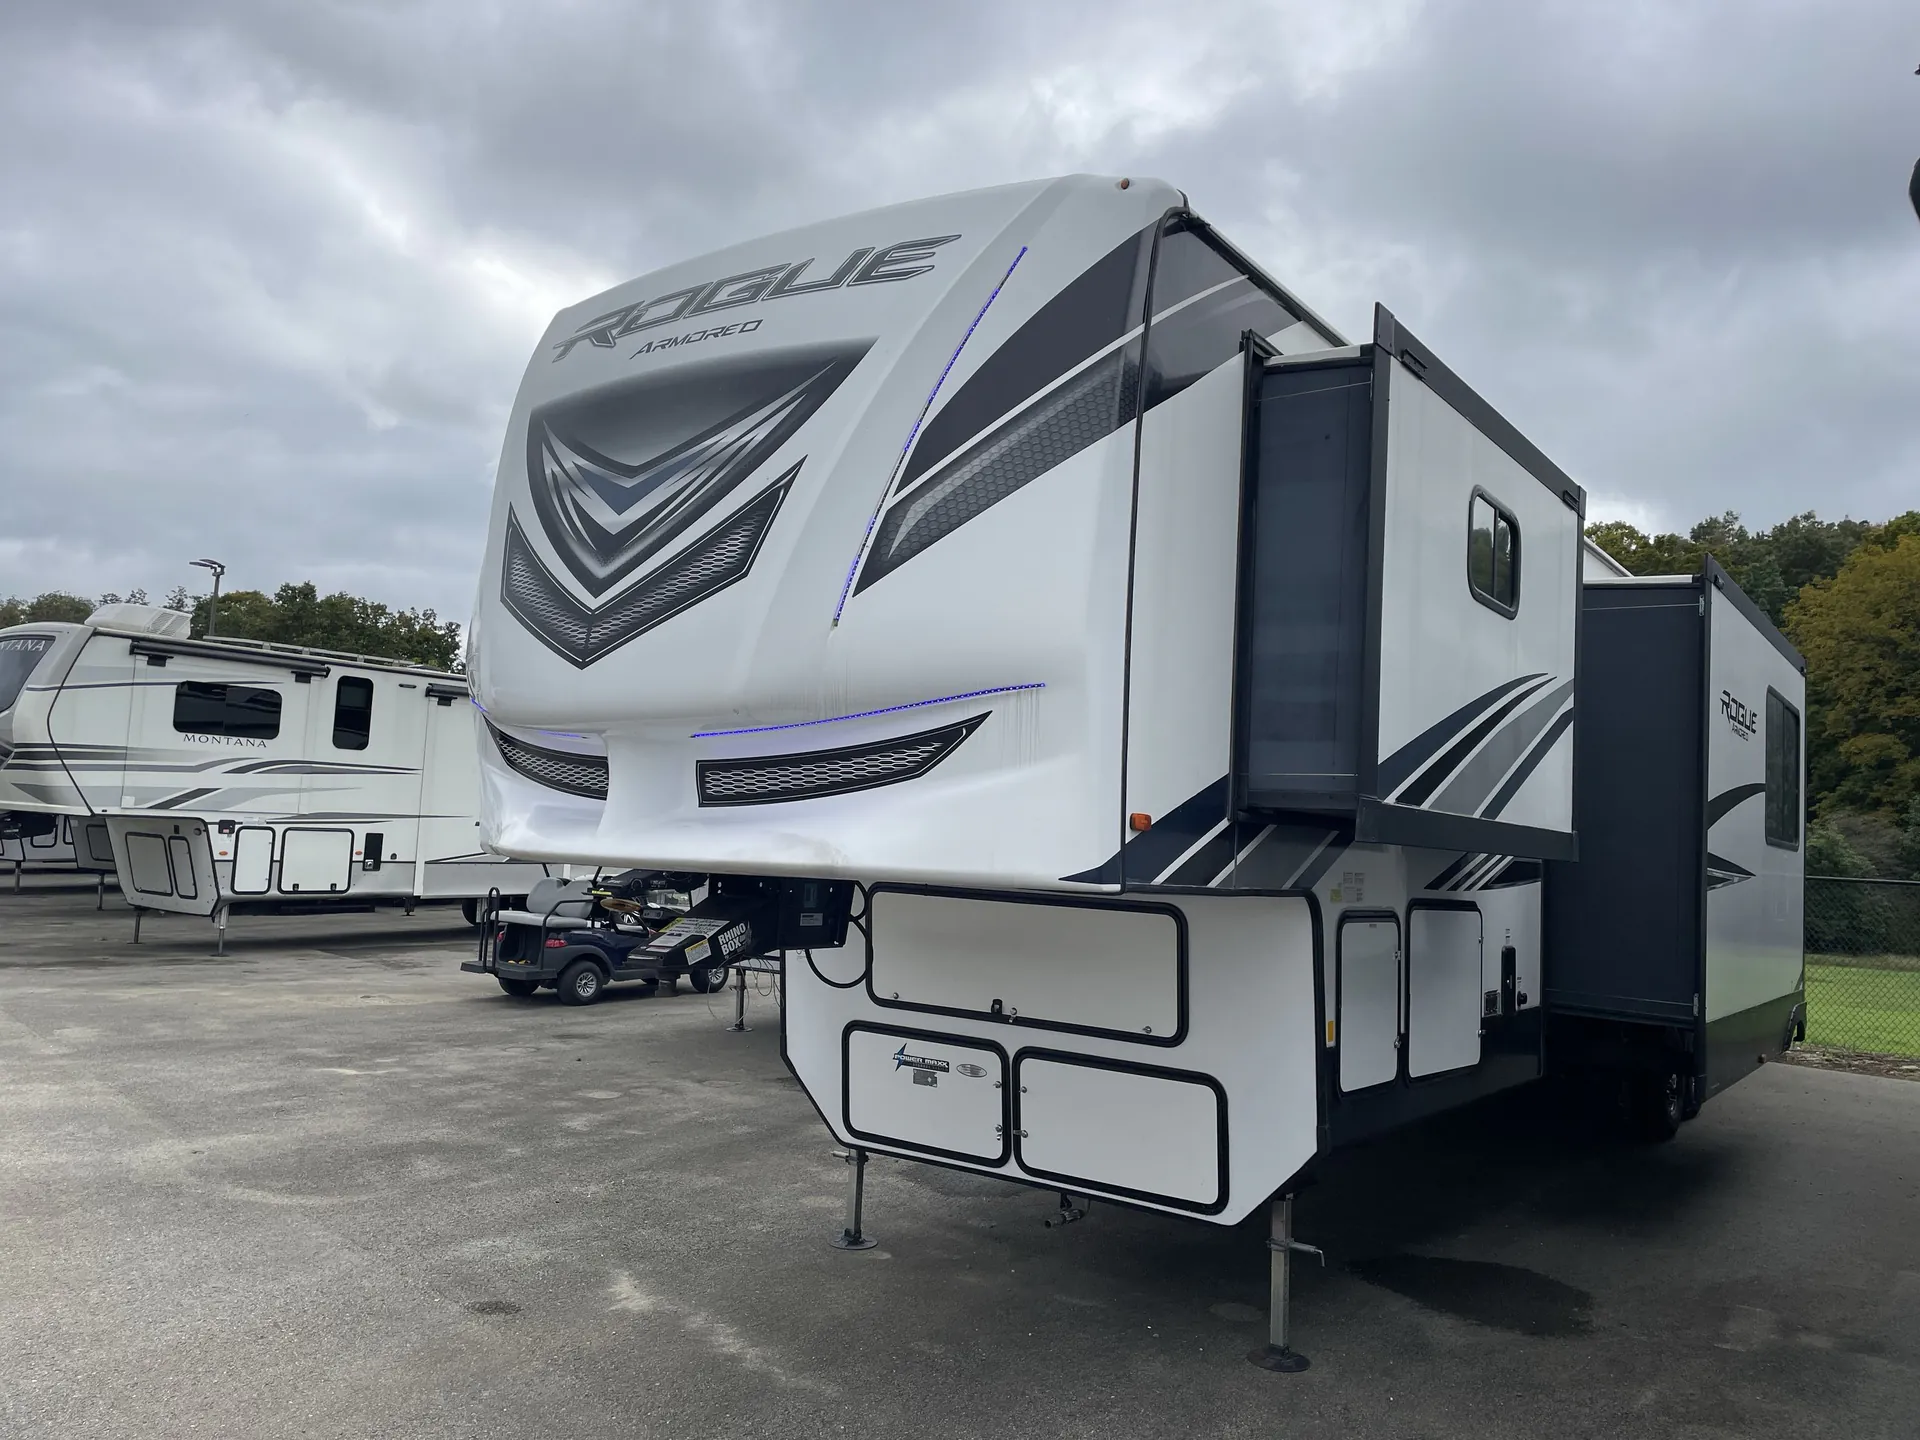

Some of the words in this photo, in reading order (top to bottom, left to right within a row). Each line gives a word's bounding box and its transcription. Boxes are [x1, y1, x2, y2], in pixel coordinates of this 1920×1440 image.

[551, 234, 963, 363] ROGUE
[629, 319, 764, 360] ARMORED
[1719, 689, 1758, 734] ROGUE
[183, 734, 267, 748] MONTANA
[718, 922, 746, 946] RHINO
[720, 936, 742, 956] BOX
[894, 1053, 923, 1064] POWER
